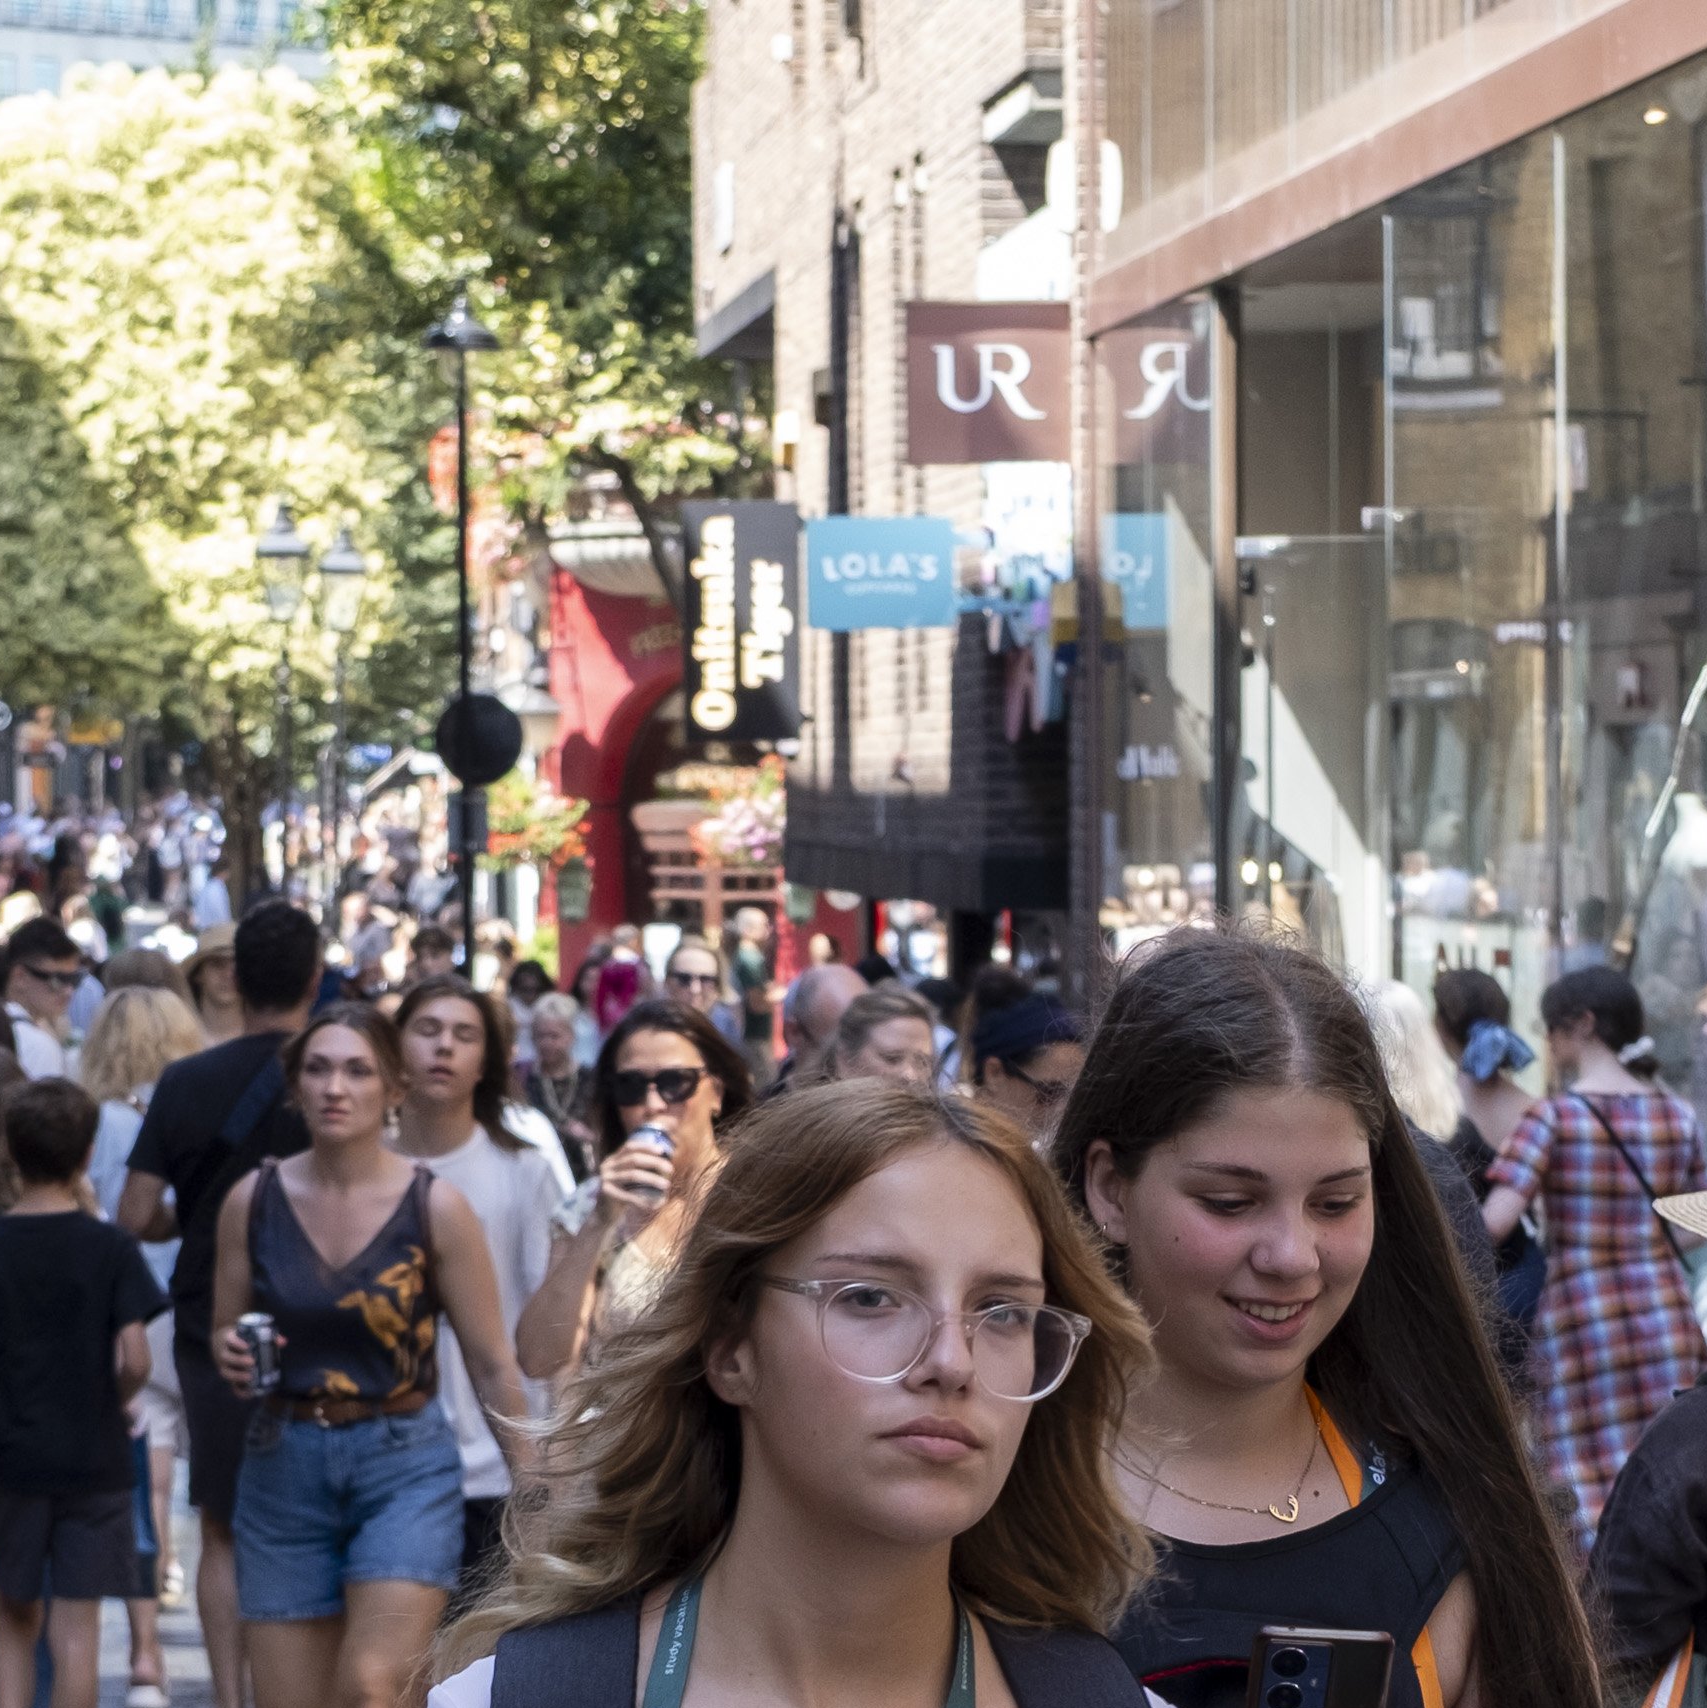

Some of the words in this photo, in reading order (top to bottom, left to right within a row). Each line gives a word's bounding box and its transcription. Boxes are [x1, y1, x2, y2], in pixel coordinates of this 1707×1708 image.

[931, 344, 1047, 420] UR
[821, 553, 939, 582] LOLA'S
[665, 1640, 682, 1675] study
